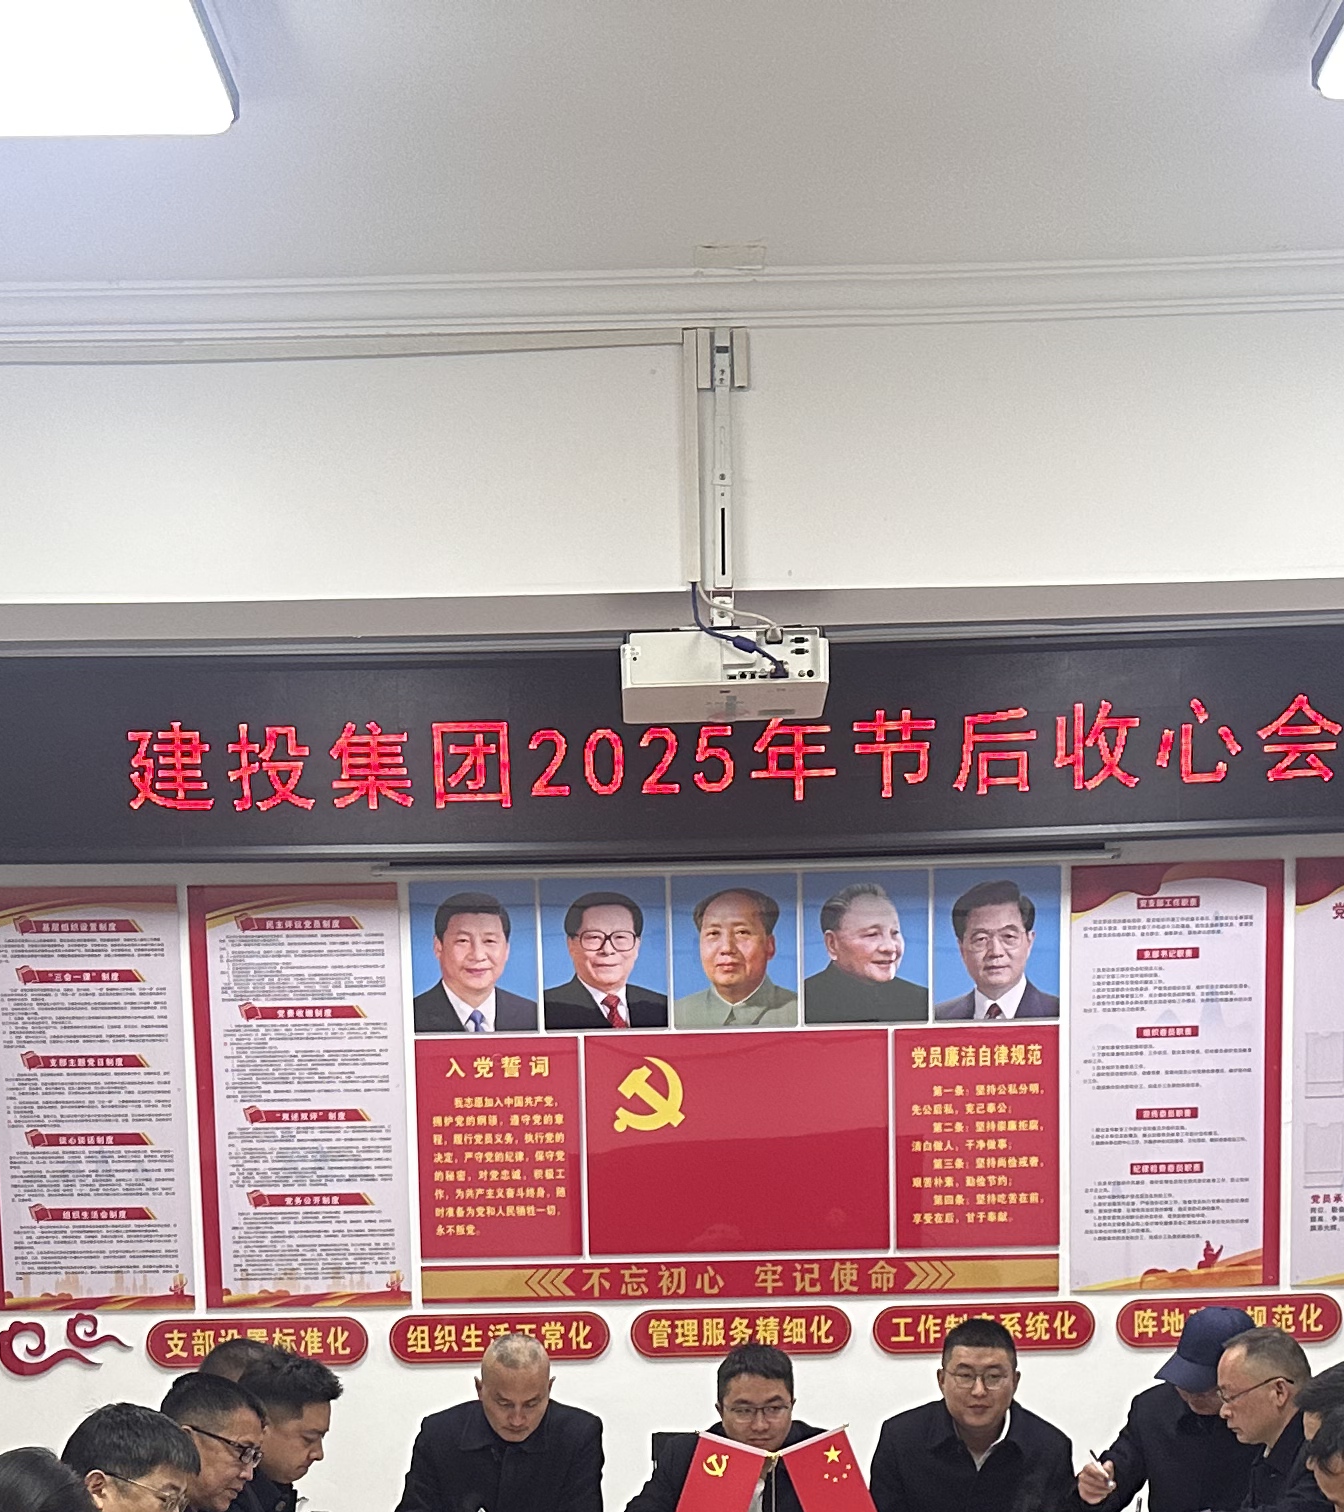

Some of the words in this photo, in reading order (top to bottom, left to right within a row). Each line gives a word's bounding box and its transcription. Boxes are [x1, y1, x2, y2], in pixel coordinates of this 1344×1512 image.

[127, 693, 1344, 812] 建投集团2025年节后收心会
[445, 1055, 550, 1078] 入党誓词
[911, 1044, 1043, 1068] 党员廉洁自律规范
[581, 1265, 725, 1297] 不忘初心
[755, 1260, 897, 1294] 牢记使命
[648, 1314, 834, 1348] 管理服务精细化
[890, 1310, 1078, 1344] 工作系统化
[1133, 1303, 1323, 1338] 阵地规范化
